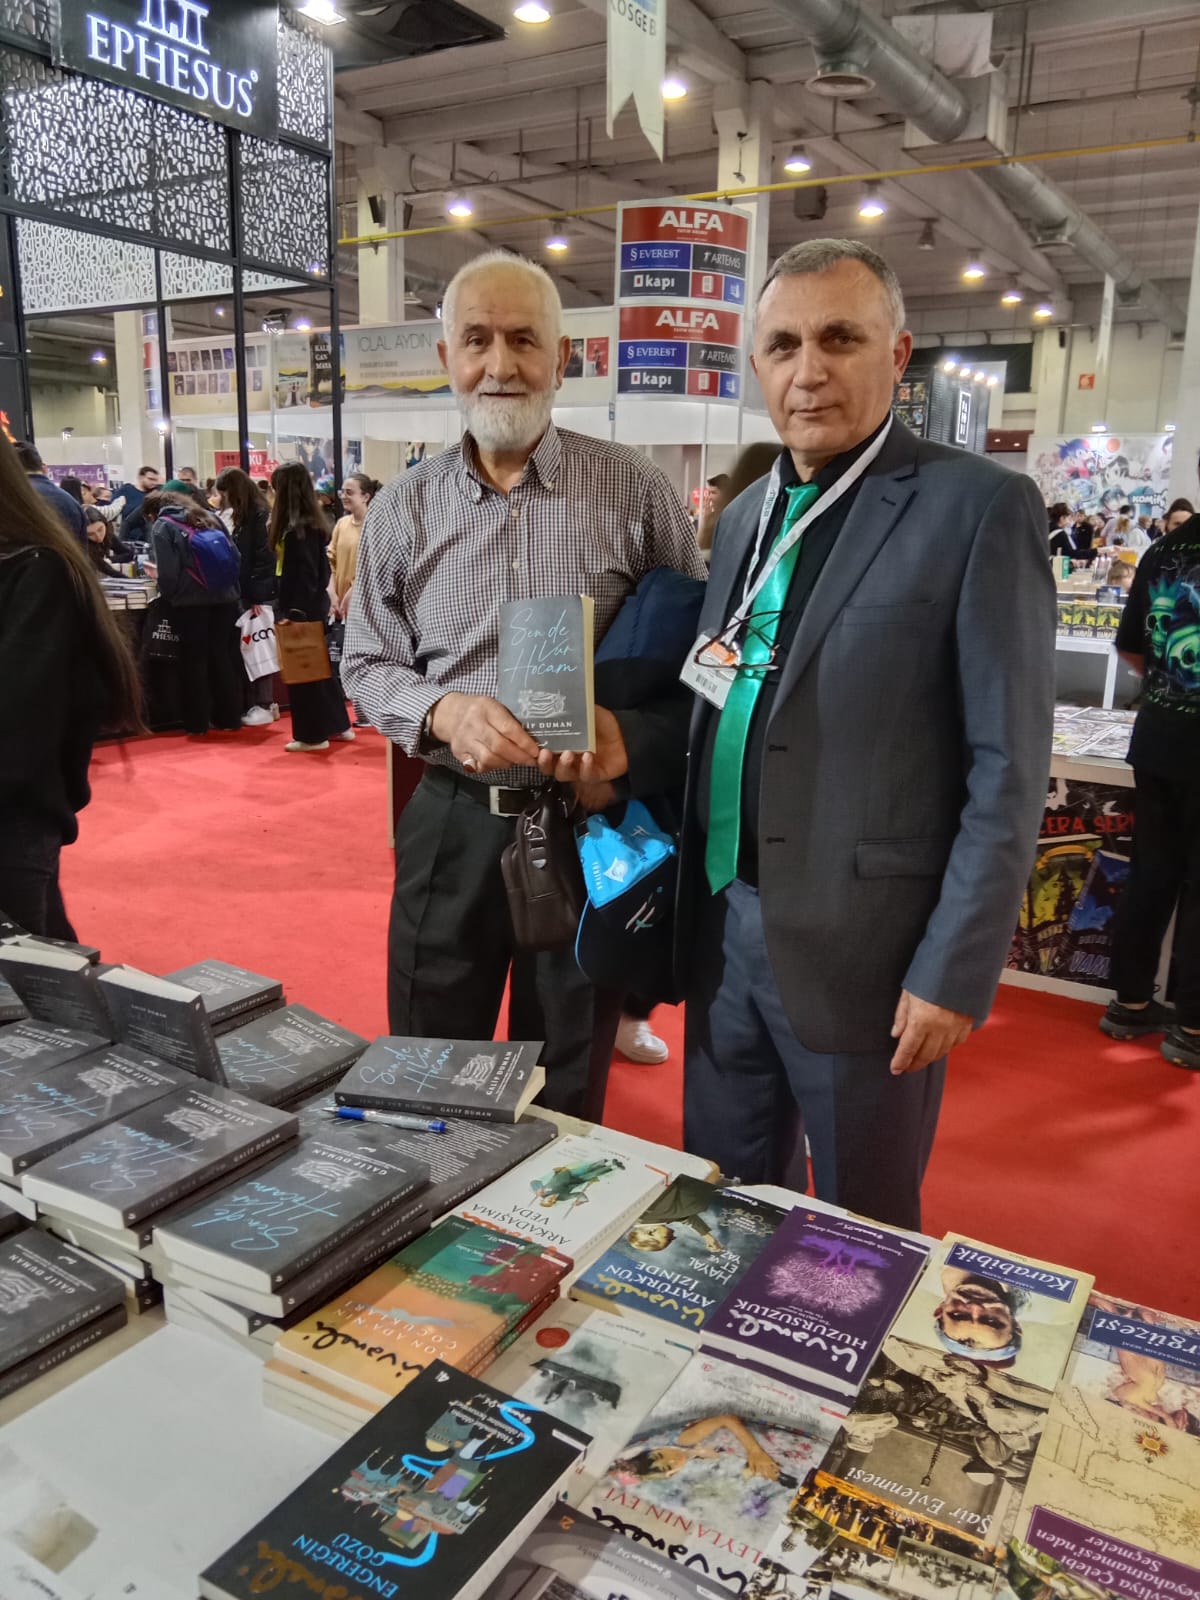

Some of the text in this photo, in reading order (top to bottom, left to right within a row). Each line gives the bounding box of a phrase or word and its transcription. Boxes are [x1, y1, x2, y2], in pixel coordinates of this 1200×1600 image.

[86, 14, 253, 117] EPHESUS
[658, 210, 723, 232] ALFA
[639, 249, 680, 259] EVEREST
[655, 310, 719, 330] ALFA
[636, 347, 677, 357] EVEREST
[249, 453, 263, 465] KU
[510, 608, 570, 646] Sen de
[504, 643, 577, 689] Hocam
[311, 1148, 389, 1177] GALİP DUMAN
[472, 1203, 572, 1246] ARKADAŞIMA
[511, 1204, 550, 1225] VEDA
[8, 1252, 77, 1295] GALİP DUMAN
[604, 1263, 717, 1309] ATATÜRK'ÜN
[635, 1261, 700, 1293] İZİNDE
[687, 1256, 733, 1286] HAYAL
[719, 1263, 739, 1275] ET
[954, 1246, 1072, 1293] Karabibik
[725, 1308, 859, 1374] Livaneli
[734, 1298, 868, 1351] HUZURSUZLUK
[1094, 1316, 1200, 1357] rgüzeşt
[410, 1336, 448, 1361] SON
[844, 1466, 946, 1516] Evlenmesi
[949, 1506, 994, 1535] Şair
[292, 1534, 400, 1600] ENGEREĞİN
[331, 1532, 387, 1568] GÖZÜ
[1084, 1535, 1163, 1573] Seçmeler
